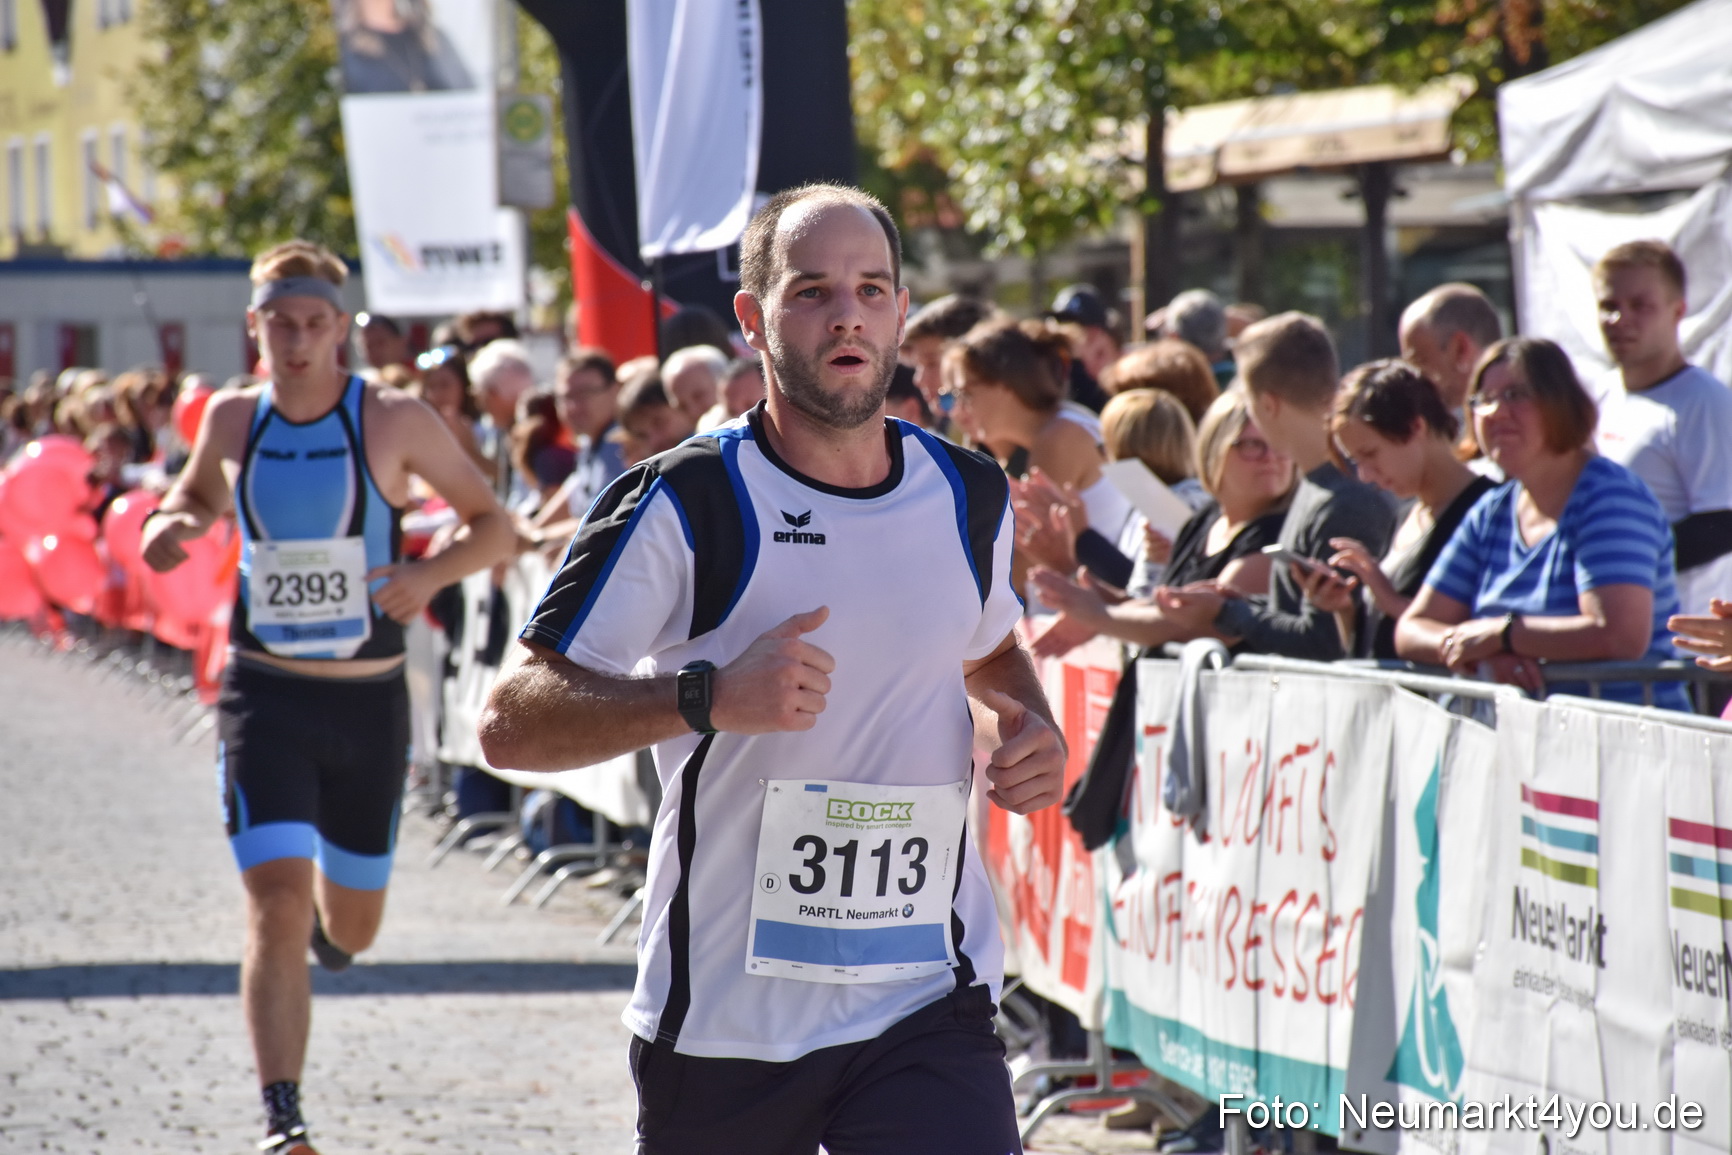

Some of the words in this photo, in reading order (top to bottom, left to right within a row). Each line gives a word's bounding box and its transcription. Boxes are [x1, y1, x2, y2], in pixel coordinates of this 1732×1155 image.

[773, 528, 826, 545] erima
[266, 571, 348, 607] 2393
[827, 799, 914, 822] BOCK
[825, 820, 854, 830] inspired
[856, 821, 865, 830] by
[885, 821, 912, 829] concepts
[788, 834, 929, 897] 3113
[766, 878, 775, 889] D
[799, 904, 843, 920] PARTL
[846, 906, 899, 920] Neumarkt
